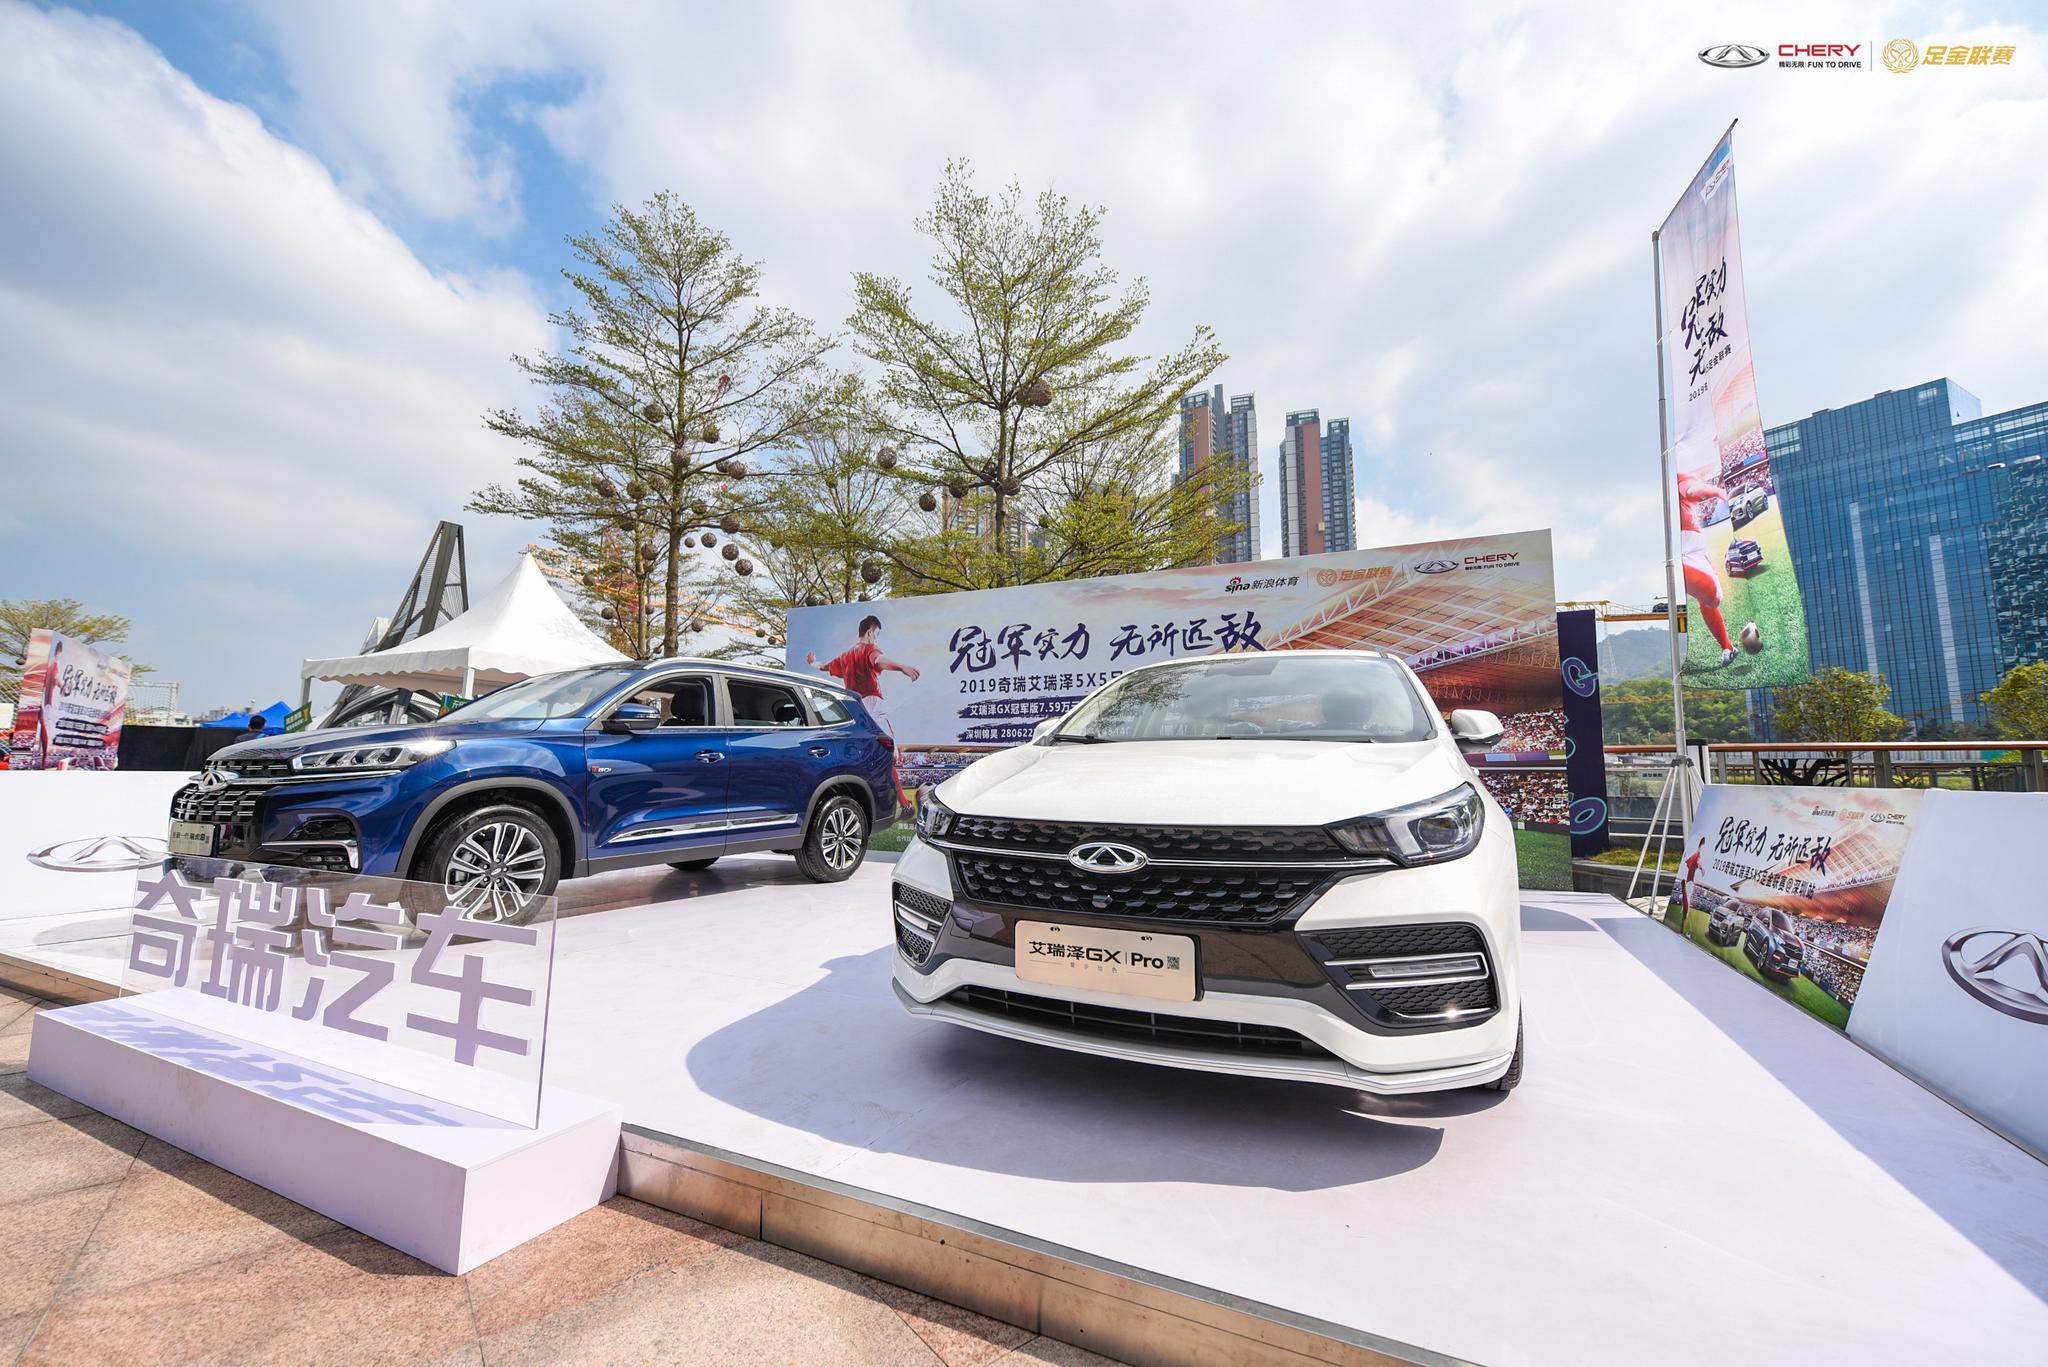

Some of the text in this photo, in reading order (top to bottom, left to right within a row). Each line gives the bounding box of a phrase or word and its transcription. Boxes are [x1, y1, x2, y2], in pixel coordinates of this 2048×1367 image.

[1464, 552, 1519, 564] CHERY
[1225, 576, 1299, 594] sina 新浪体育
[1339, 566, 1393, 581] 足金联赛
[949, 610, 1267, 674] 冠军实力 无所匹敌
[1714, 816, 1768, 857] 冠军实力
[129, 868, 539, 1067] 奇瑞汽车
[1028, 940, 1122, 964] 艾瑞泽GX
[1131, 952, 1164, 969] Pro
